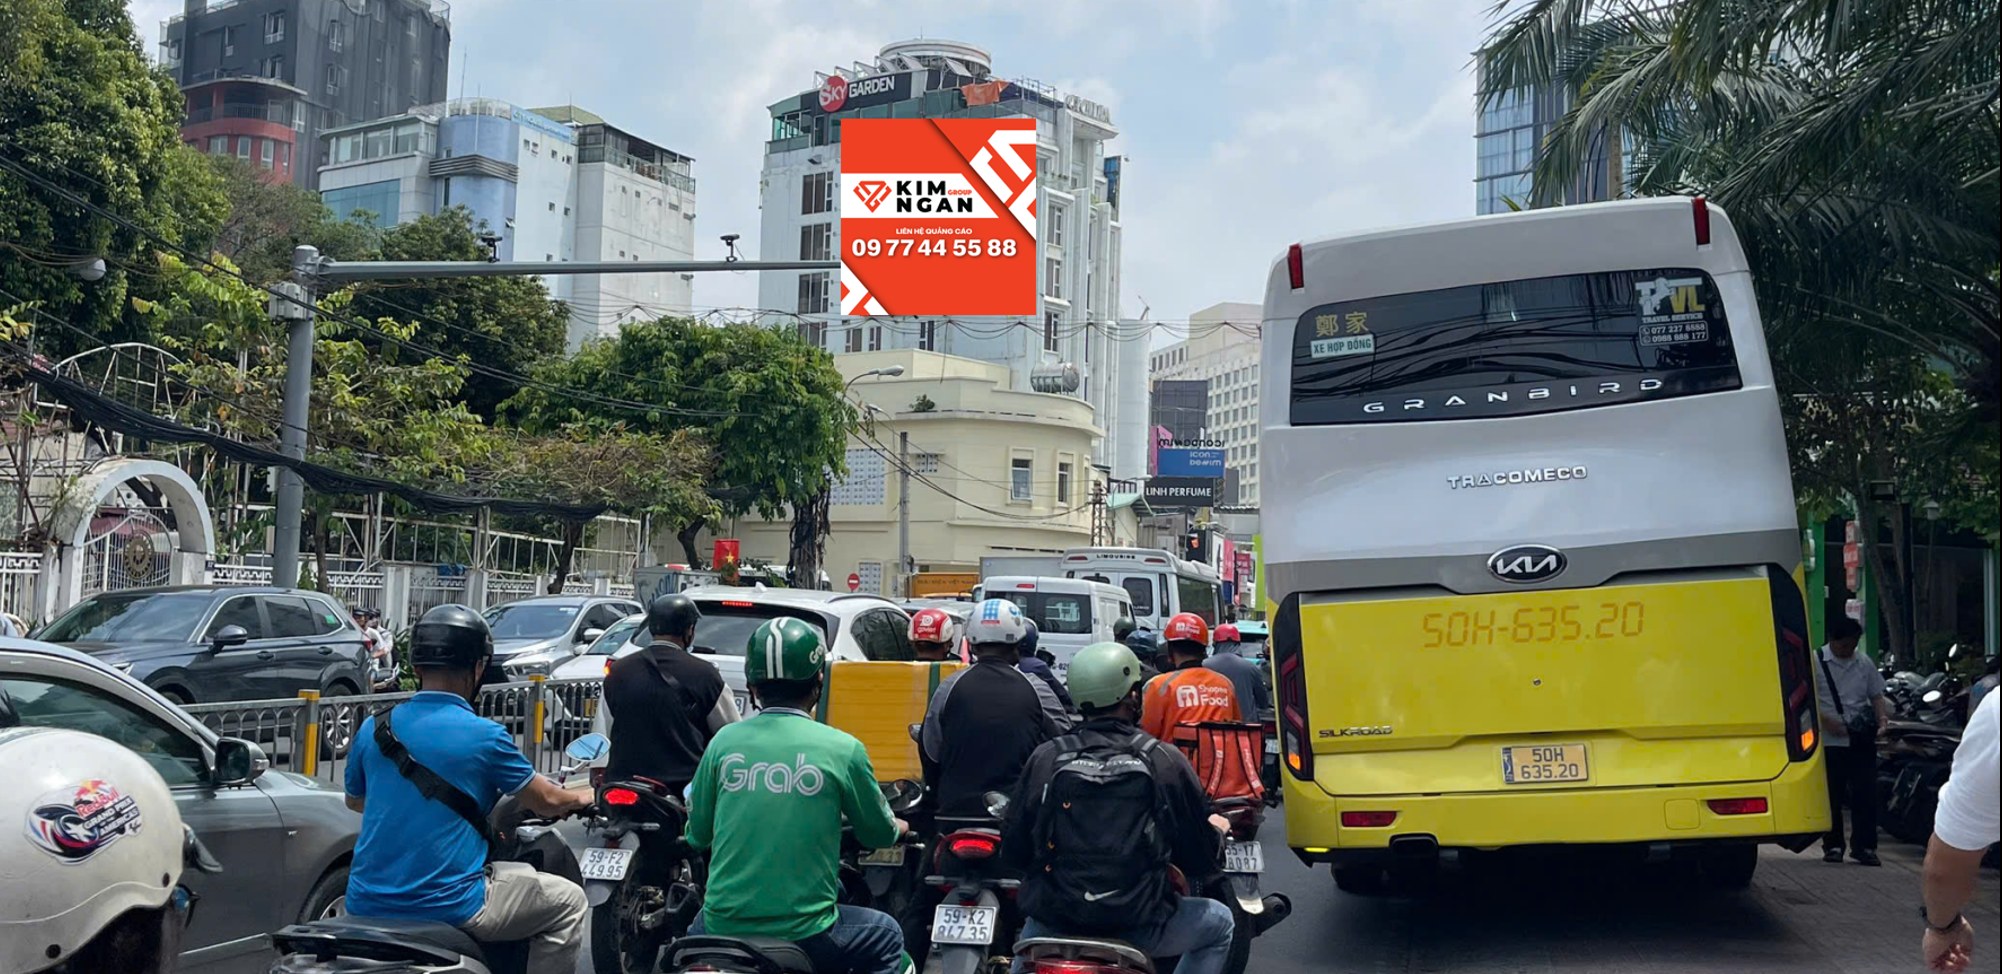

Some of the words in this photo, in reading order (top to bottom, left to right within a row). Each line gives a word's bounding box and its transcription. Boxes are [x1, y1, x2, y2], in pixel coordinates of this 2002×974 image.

[819, 84, 845, 106] SKY
[849, 75, 895, 98] GARDEN
[1313, 344, 1325, 354] XE
[1363, 379, 1662, 413] GRANBIRD
[1447, 465, 1588, 489] TRACOMECO
[1146, 486, 1167, 497] LINH
[1169, 486, 1212, 498] PERFUME
[1496, 554, 1557, 575] KIA
[1422, 601, 1645, 648] 50H-635.20
[1200, 694, 1229, 707] Food
[1319, 726, 1393, 739] SILKROAD
[1532, 747, 1564, 763] 50H
[720, 753, 824, 796] Grab
[1520, 763, 1579, 779] 635.20
[83, 807, 116, 829] GRAND
[589, 850, 624, 865] 59-F2
[943, 908, 986, 925] 59-K2
